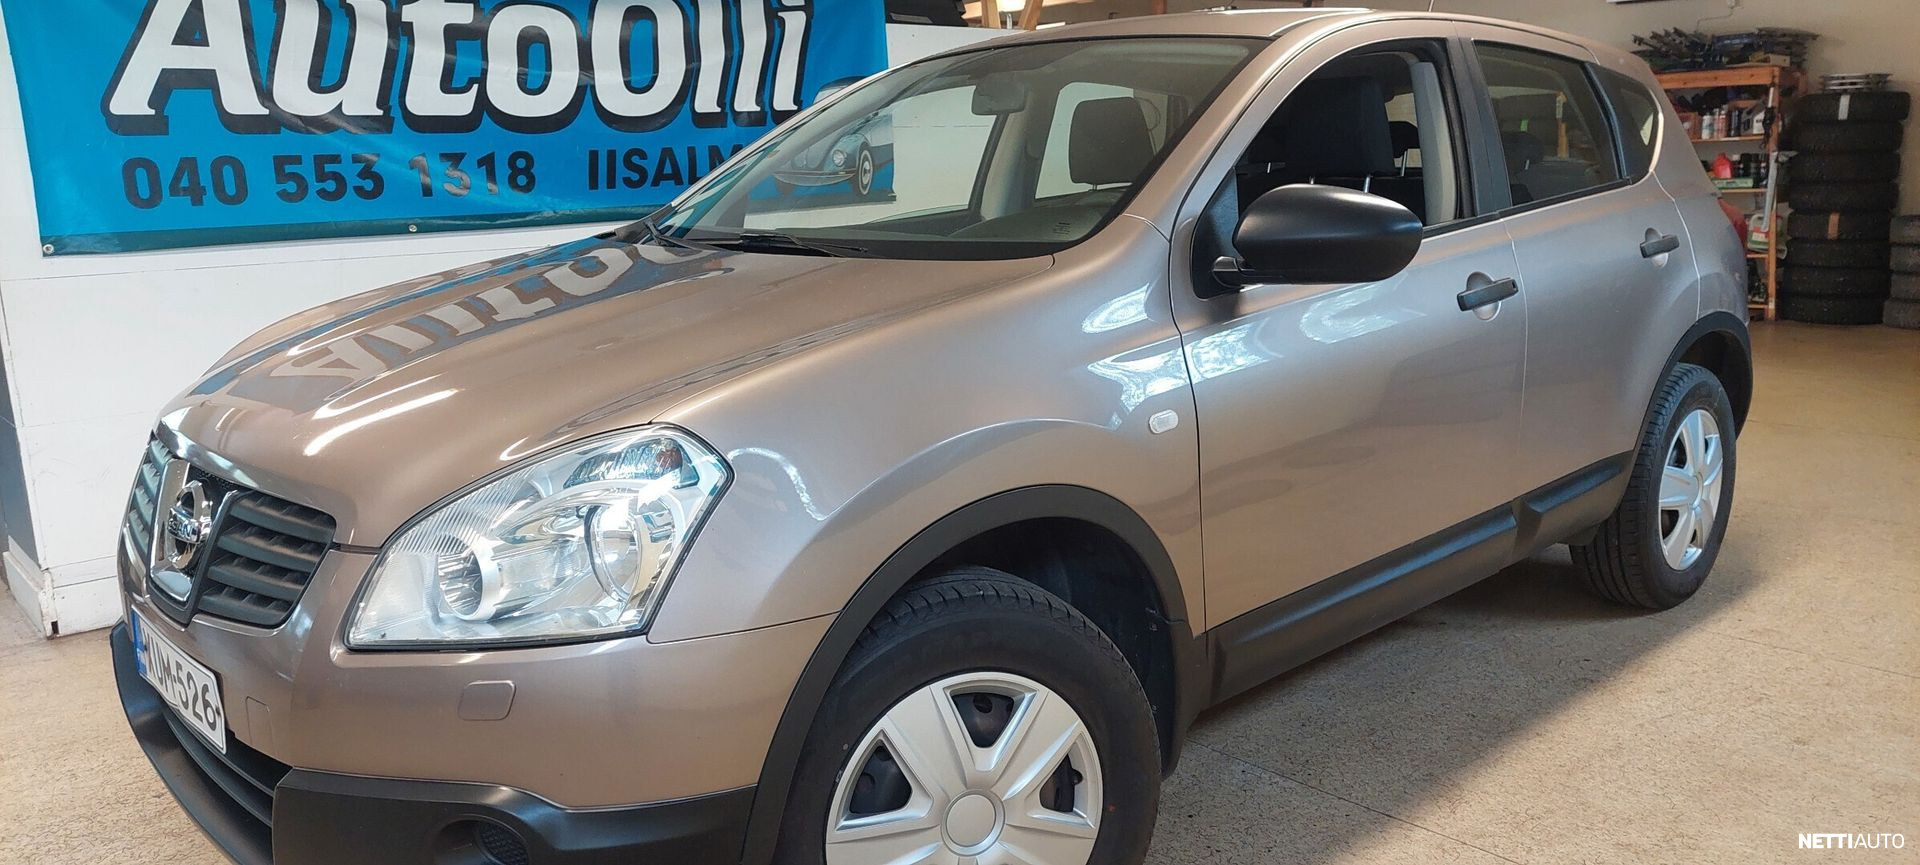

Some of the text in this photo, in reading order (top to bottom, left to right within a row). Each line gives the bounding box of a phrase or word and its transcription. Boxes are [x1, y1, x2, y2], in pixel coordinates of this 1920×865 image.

[104, 0, 810, 130] AutoOlli
[122, 155, 248, 209] 040
[272, 153, 385, 203] 553
[408, 151, 536, 198] 1318
